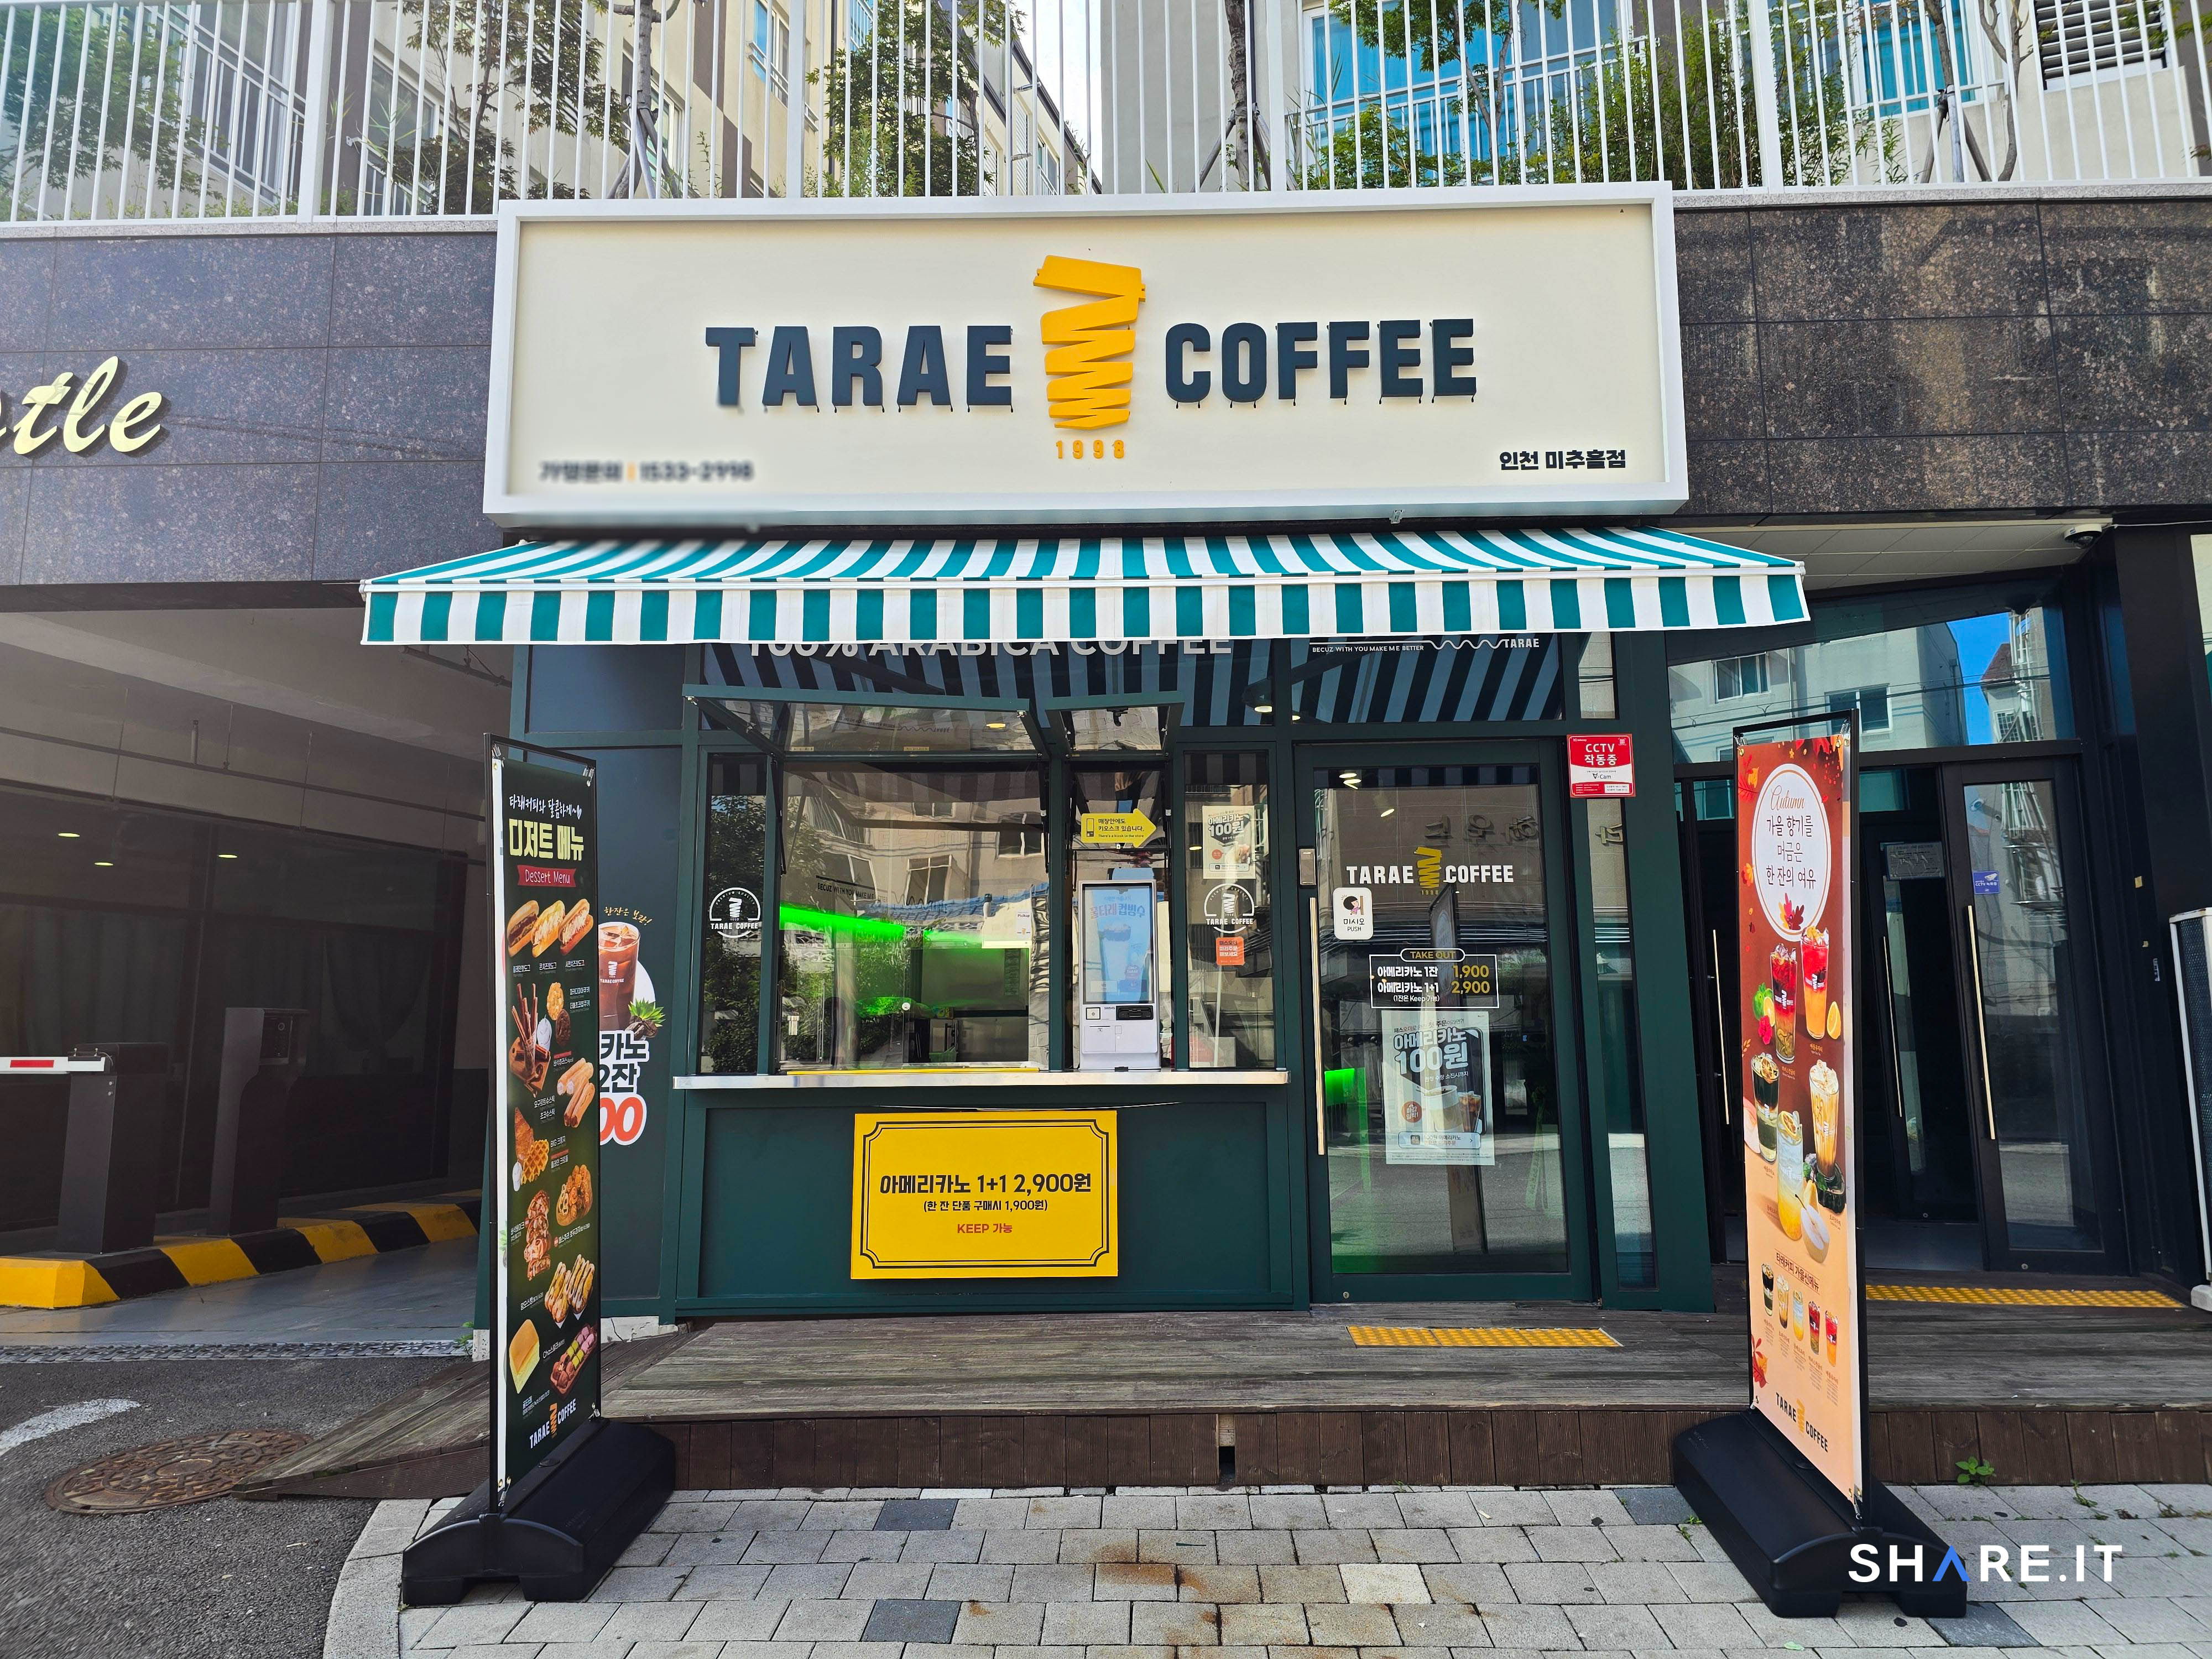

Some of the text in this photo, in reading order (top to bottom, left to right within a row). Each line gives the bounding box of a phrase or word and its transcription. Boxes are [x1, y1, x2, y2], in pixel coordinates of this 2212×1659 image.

[706, 319, 1478, 409] TARAE COFFEE
[0, 356, 162, 455] tle
[1056, 440, 1124, 459] 1998
[1499, 449, 1626, 470] 인천 미추홀점
[1504, 638, 1540, 648] TARAE
[1585, 743, 1615, 753] CCTV
[1584, 754, 1617, 766] 작동중
[509, 794, 546, 814] 타래커피와
[1771, 785, 1804, 811] Autumn
[1208, 813, 1244, 825] 아메리카노
[1208, 821, 1244, 837] 100원
[1766, 815, 1813, 837] 가을 향기를
[509, 818, 584, 861] 디저트 메뉴
[1777, 841, 1803, 863] 머금은
[525, 869, 570, 884] Dessert Menu
[1346, 865, 1514, 885] TARAE COFFEE
[1766, 865, 1817, 889] 한 잔의 여유
[603, 906, 653, 926] 한잔은 보관!
[1378, 966, 1438, 977] 아메리카노 1잔
[1453, 965, 1489, 979] 1,900
[1378, 982, 1439, 993] 아메리카노 1+1
[1451, 981, 1490, 994] 2,900
[1394, 1027, 1467, 1050] 아메리카노
[1394, 1041, 1469, 1075] 100원
[880, 1173, 1091, 1196] 아메리카노 1+1 2,900원
[924, 1199, 1048, 1213] (한 잔 단품 구매시 1,900원)
[957, 1223, 1013, 1234] KEEP 가능
[1776, 1253, 1819, 1292] 타래커피 가을신메뉴
[529, 1421, 550, 1449] TARAE
[557, 1398, 576, 1425] COFFEE
[1776, 1391, 1828, 1453] TARAE COFFEE
